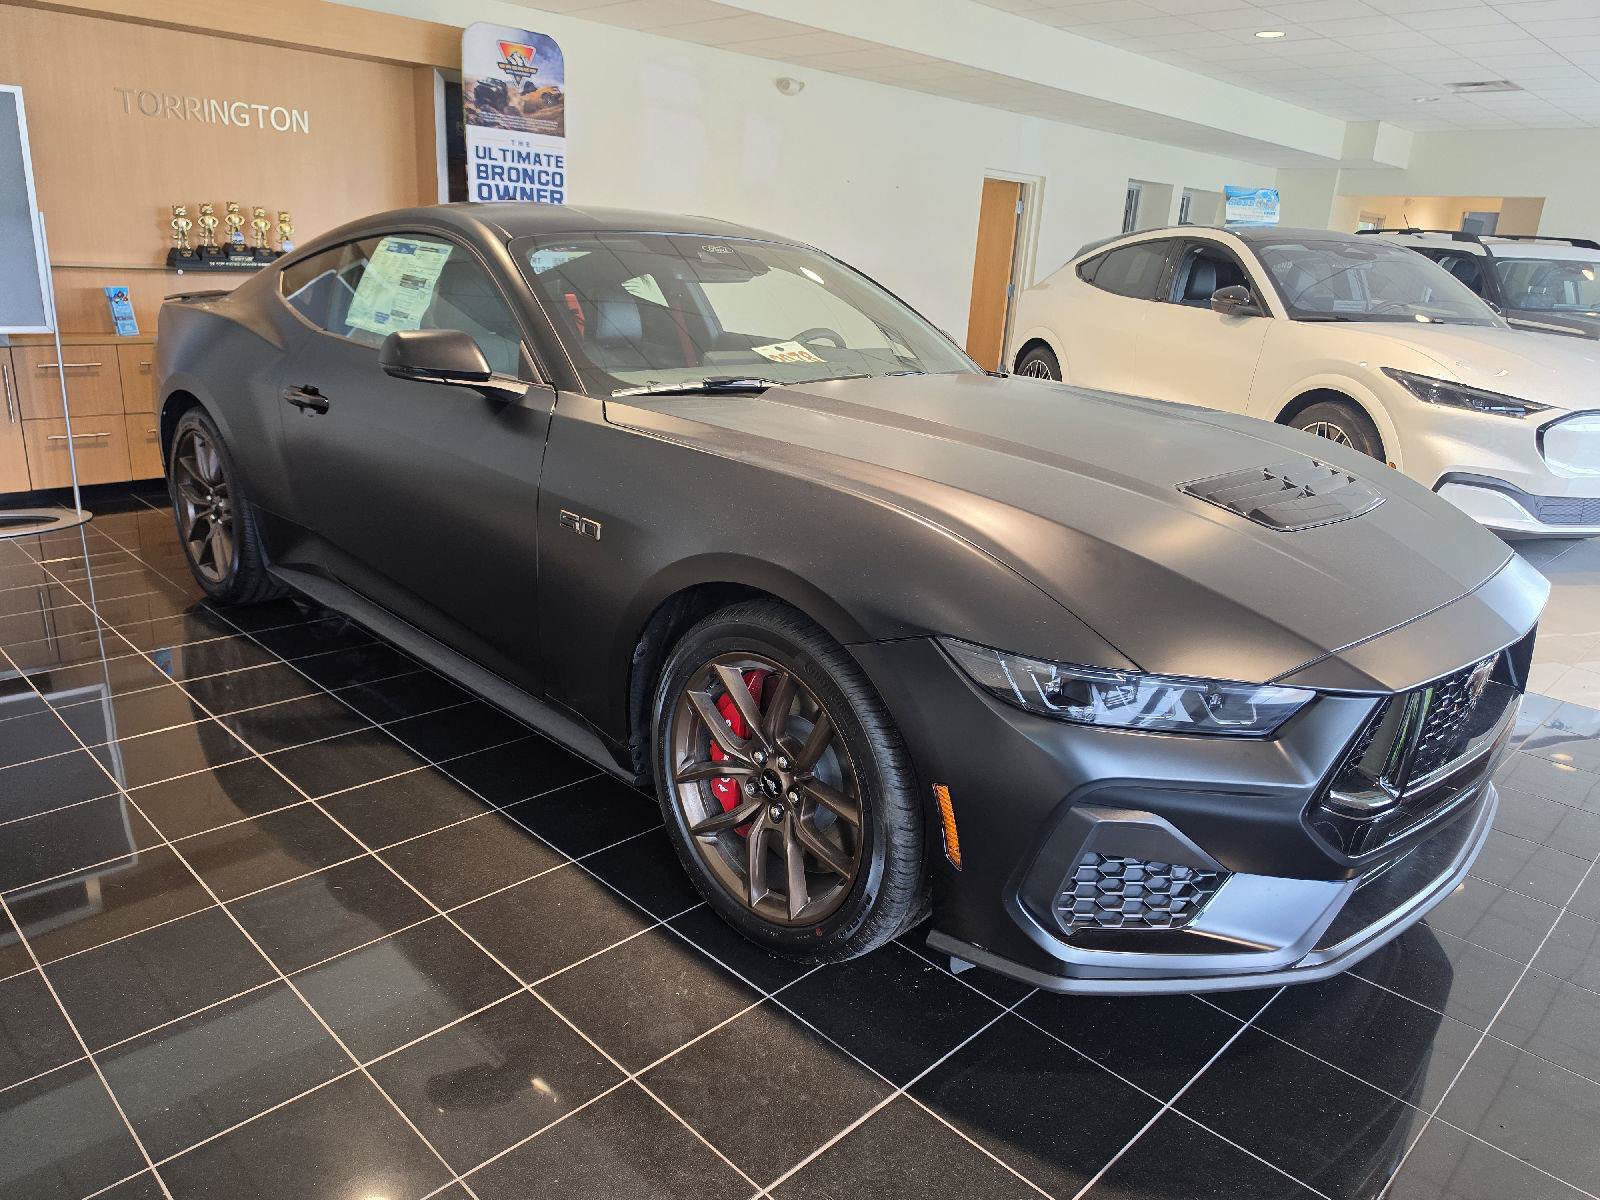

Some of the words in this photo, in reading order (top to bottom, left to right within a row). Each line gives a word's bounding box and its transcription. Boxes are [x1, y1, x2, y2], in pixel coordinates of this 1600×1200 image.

[113, 86, 309, 134] TORRINGTON
[475, 145, 564, 169] ULTIMATE
[476, 163, 564, 188] BRONCO
[477, 182, 564, 204] OWNER
